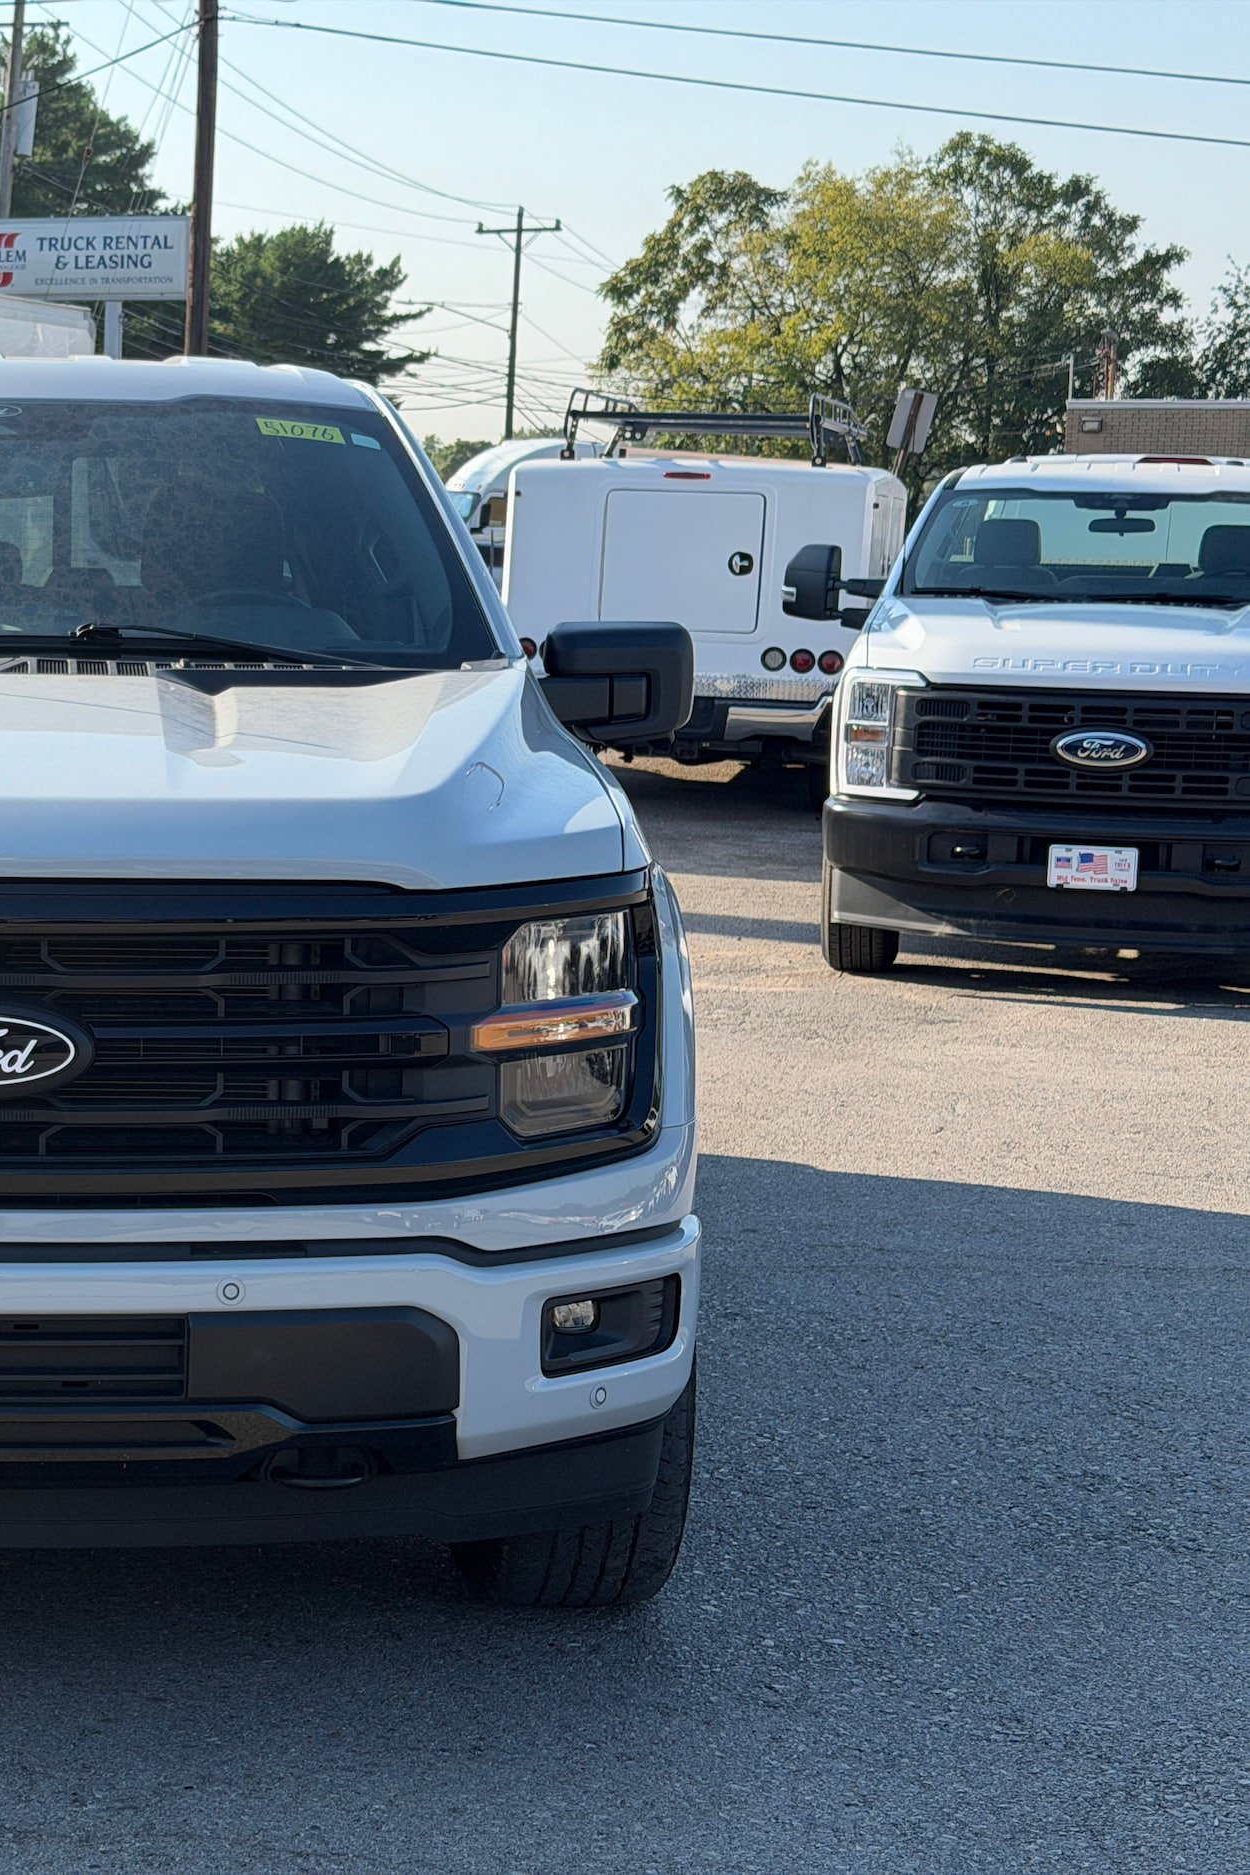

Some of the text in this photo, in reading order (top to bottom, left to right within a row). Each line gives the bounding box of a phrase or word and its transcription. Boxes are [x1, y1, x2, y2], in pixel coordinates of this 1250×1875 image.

[36, 235, 174, 252] TRUCK RENTAL
[55, 254, 152, 270] & LEASING
[35, 276, 174, 286] EXCELLENCE IN TRANSPORTATION
[263, 421, 335, 441] 51076
[973, 656, 1121, 675] SUPER
[1077, 739, 1126, 759] Ford
